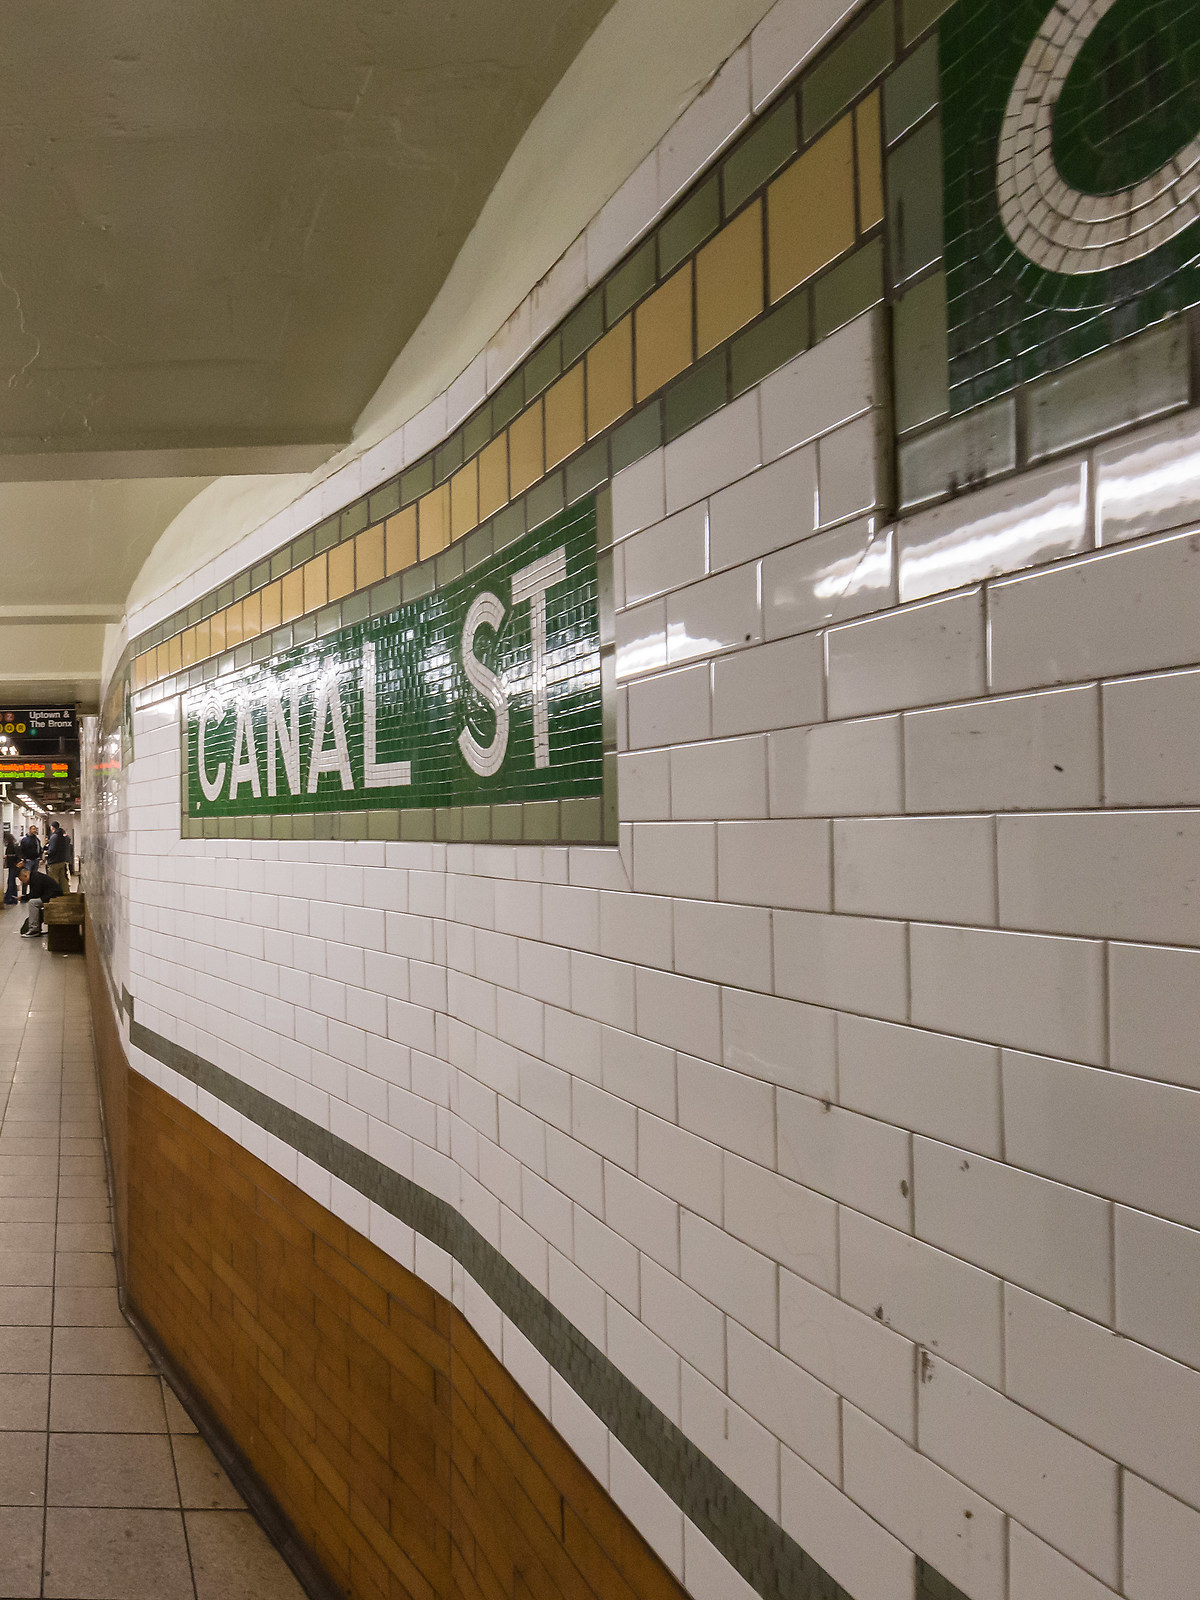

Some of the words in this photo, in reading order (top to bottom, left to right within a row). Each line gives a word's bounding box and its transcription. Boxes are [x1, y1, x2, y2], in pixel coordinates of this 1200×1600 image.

[197, 641, 412, 802] CANAL
[457, 545, 567, 778] ST
[29, 711, 60, 720] Uptown
[63, 710, 70, 718] &
[30, 720, 45, 728] The
[48, 720, 72, 728] Bronx
[24, 763, 45, 771] Bridge
